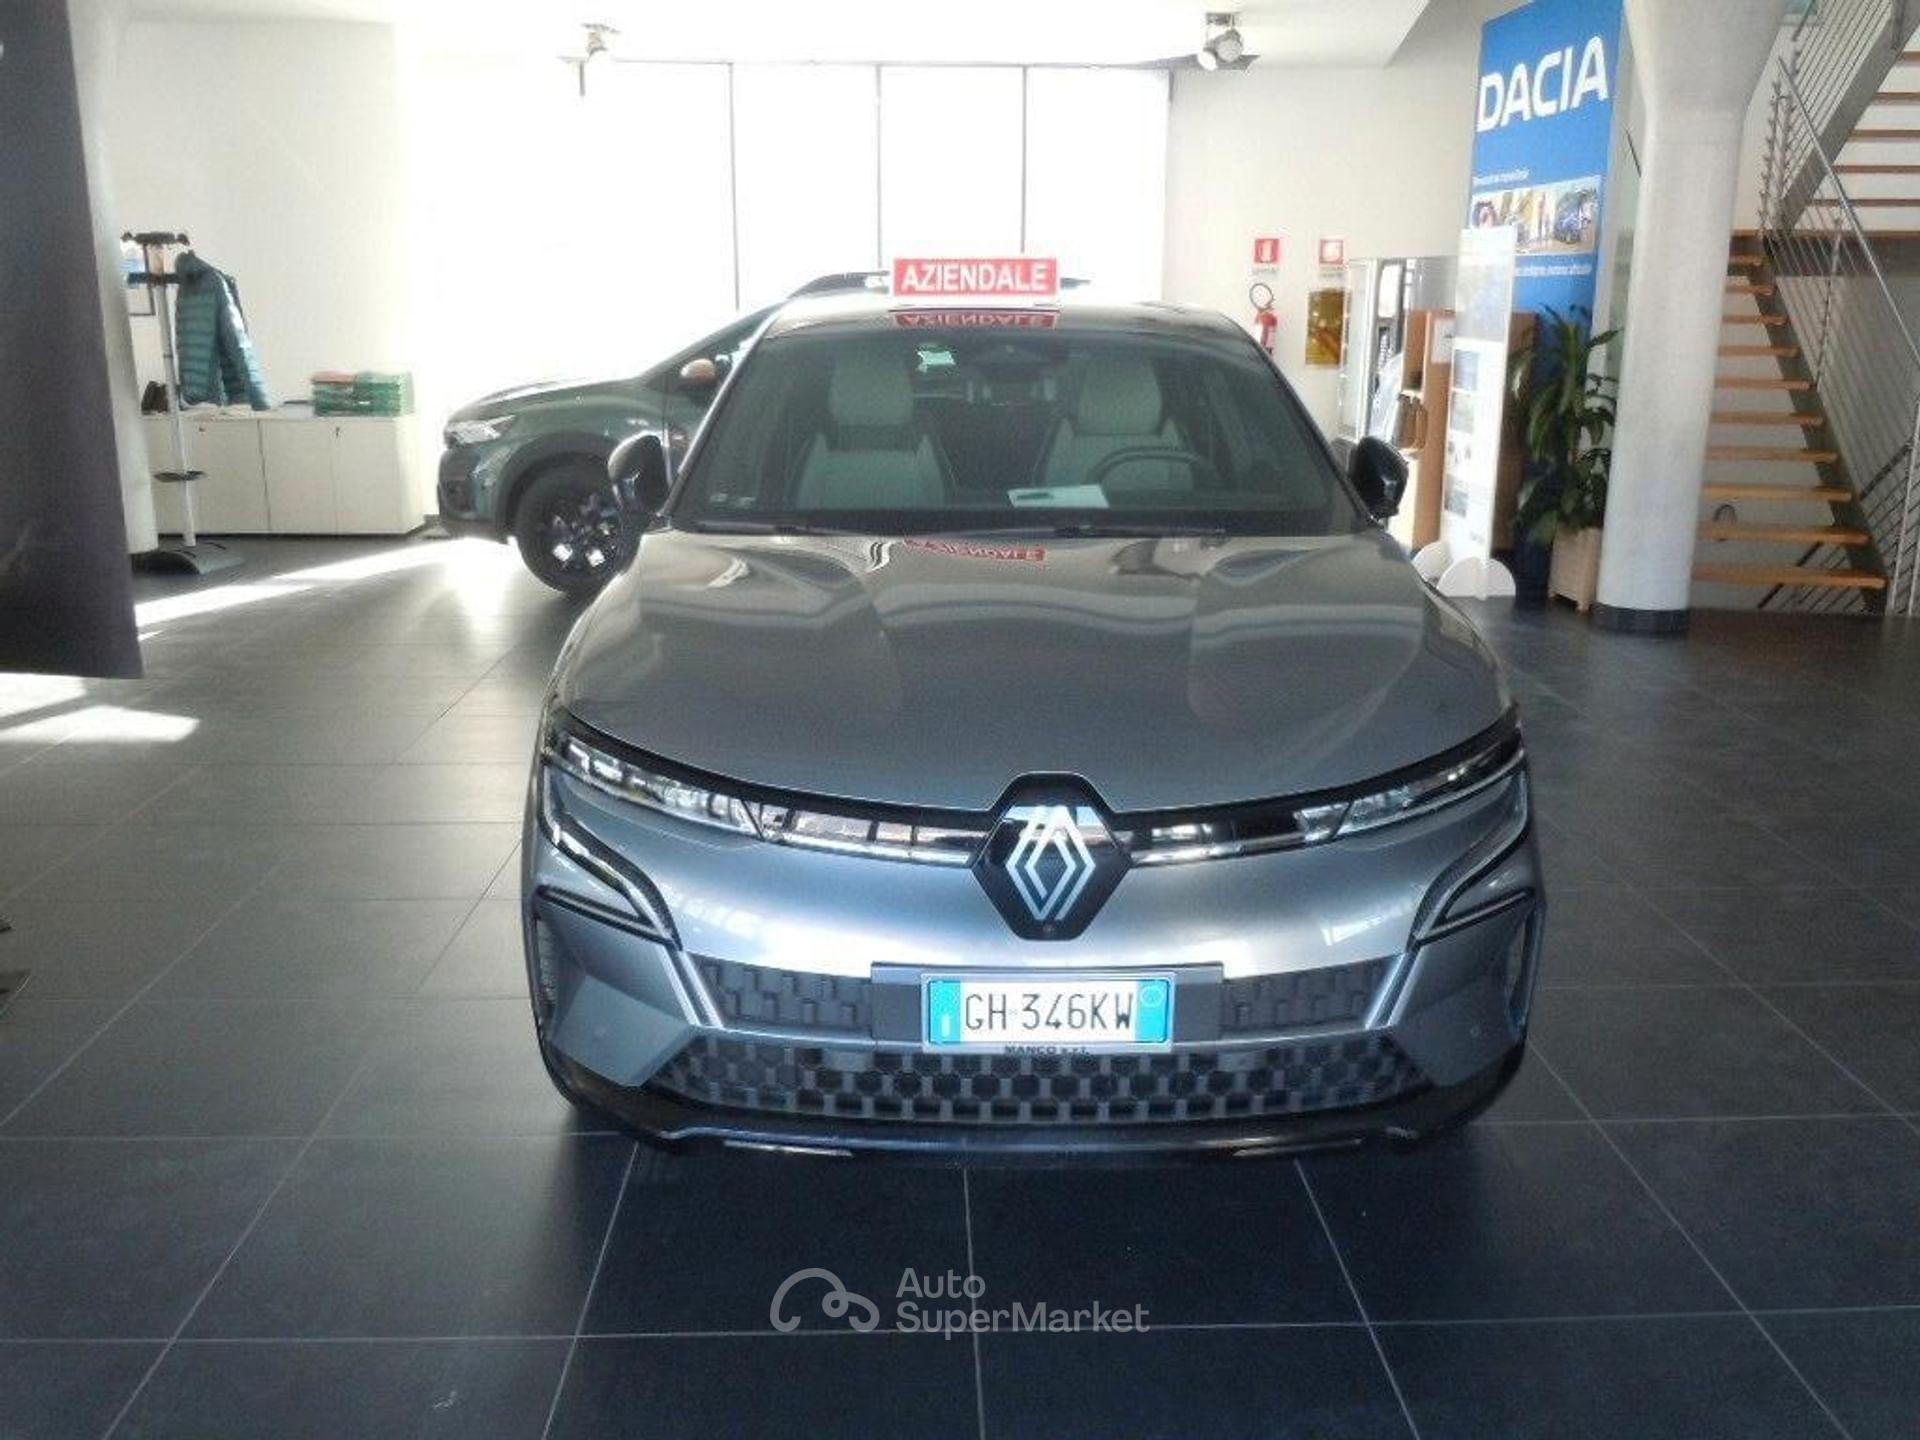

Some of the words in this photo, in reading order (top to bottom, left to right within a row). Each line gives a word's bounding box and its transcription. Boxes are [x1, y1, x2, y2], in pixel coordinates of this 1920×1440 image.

[1477, 35, 1609, 133] DACIA
[902, 263, 1048, 292] AZIENDALE
[965, 993, 1007, 1031] GH
[1021, 993, 1133, 1031] 346KW
